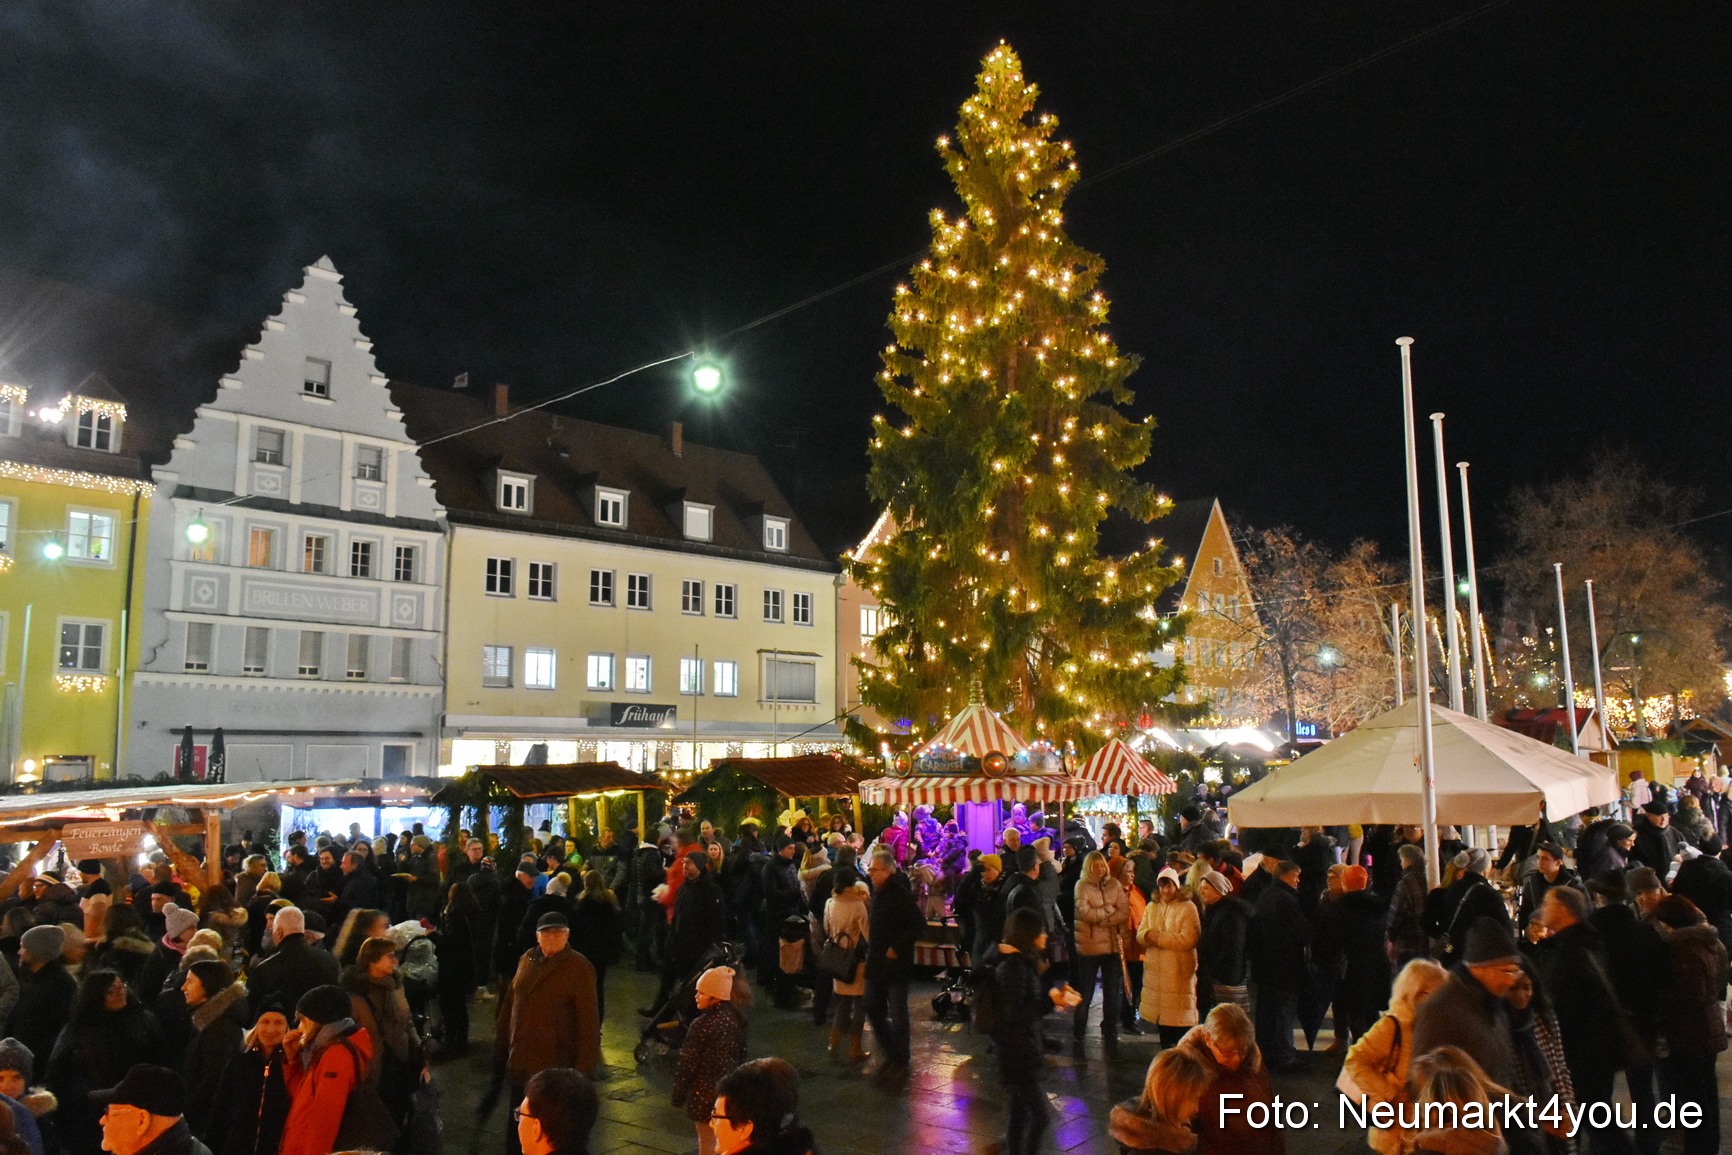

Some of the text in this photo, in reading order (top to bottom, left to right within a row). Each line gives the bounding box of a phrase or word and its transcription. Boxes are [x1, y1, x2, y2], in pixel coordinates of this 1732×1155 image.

[252, 589, 369, 612] BRILLEN WEBER
[69, 827, 142, 842] Feuerzangen
[88, 841, 123, 854] Bowle
